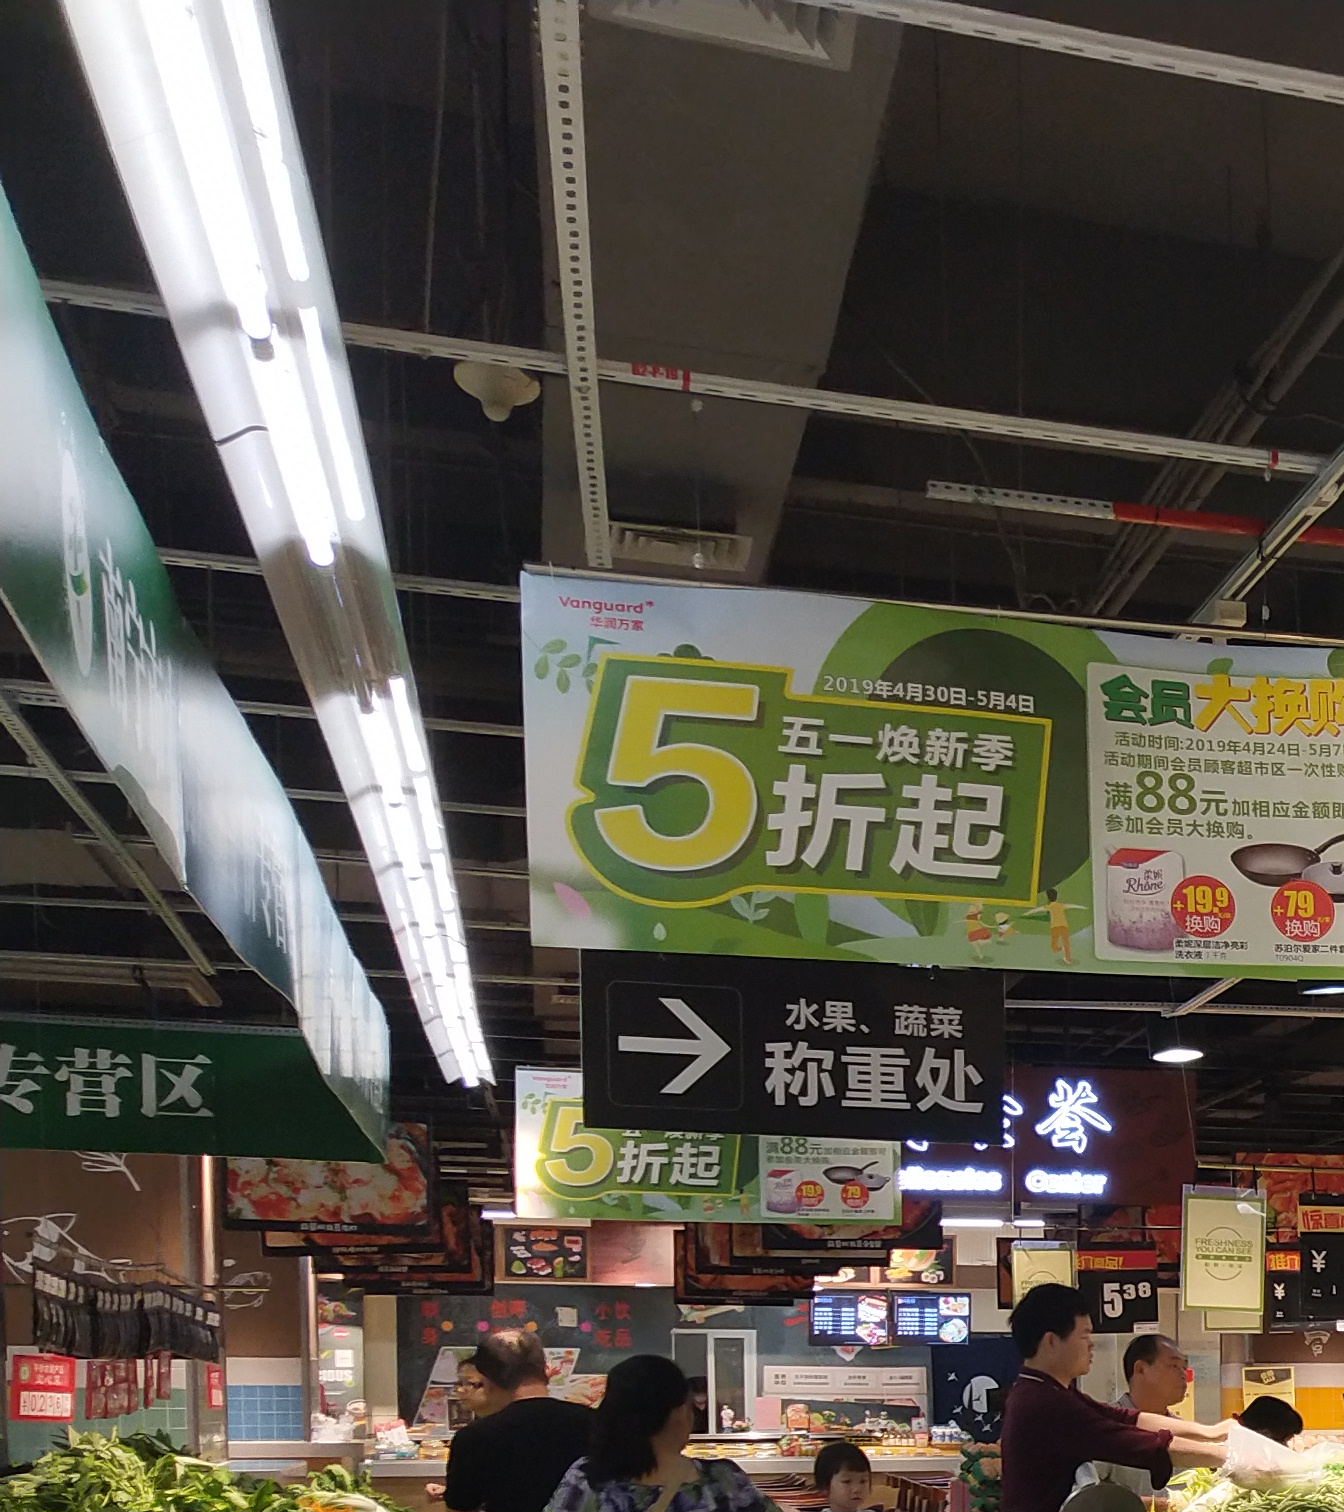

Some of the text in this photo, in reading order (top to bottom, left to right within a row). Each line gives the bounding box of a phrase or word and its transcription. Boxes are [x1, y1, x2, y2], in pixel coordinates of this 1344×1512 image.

[558, 595, 645, 614] Vanguard
[589, 616, 645, 632] 华润万家
[823, 675, 1035, 713] 2019年4月30日-5月4日
[777, 715, 1015, 772] 五一焕新季
[594, 675, 759, 871] 5
[765, 764, 1005, 879] 折起
[1185, 915, 1221, 932] 换购
[1285, 920, 1320, 937] 换购
[764, 1040, 984, 1113] 称重处
[616, 1140, 721, 1187] 折起
[1195, 1238, 1253, 1248] FRESHNESS
[1195, 1246, 1213, 1254] YOU
[1235, 1247, 1252, 1255] SEE
